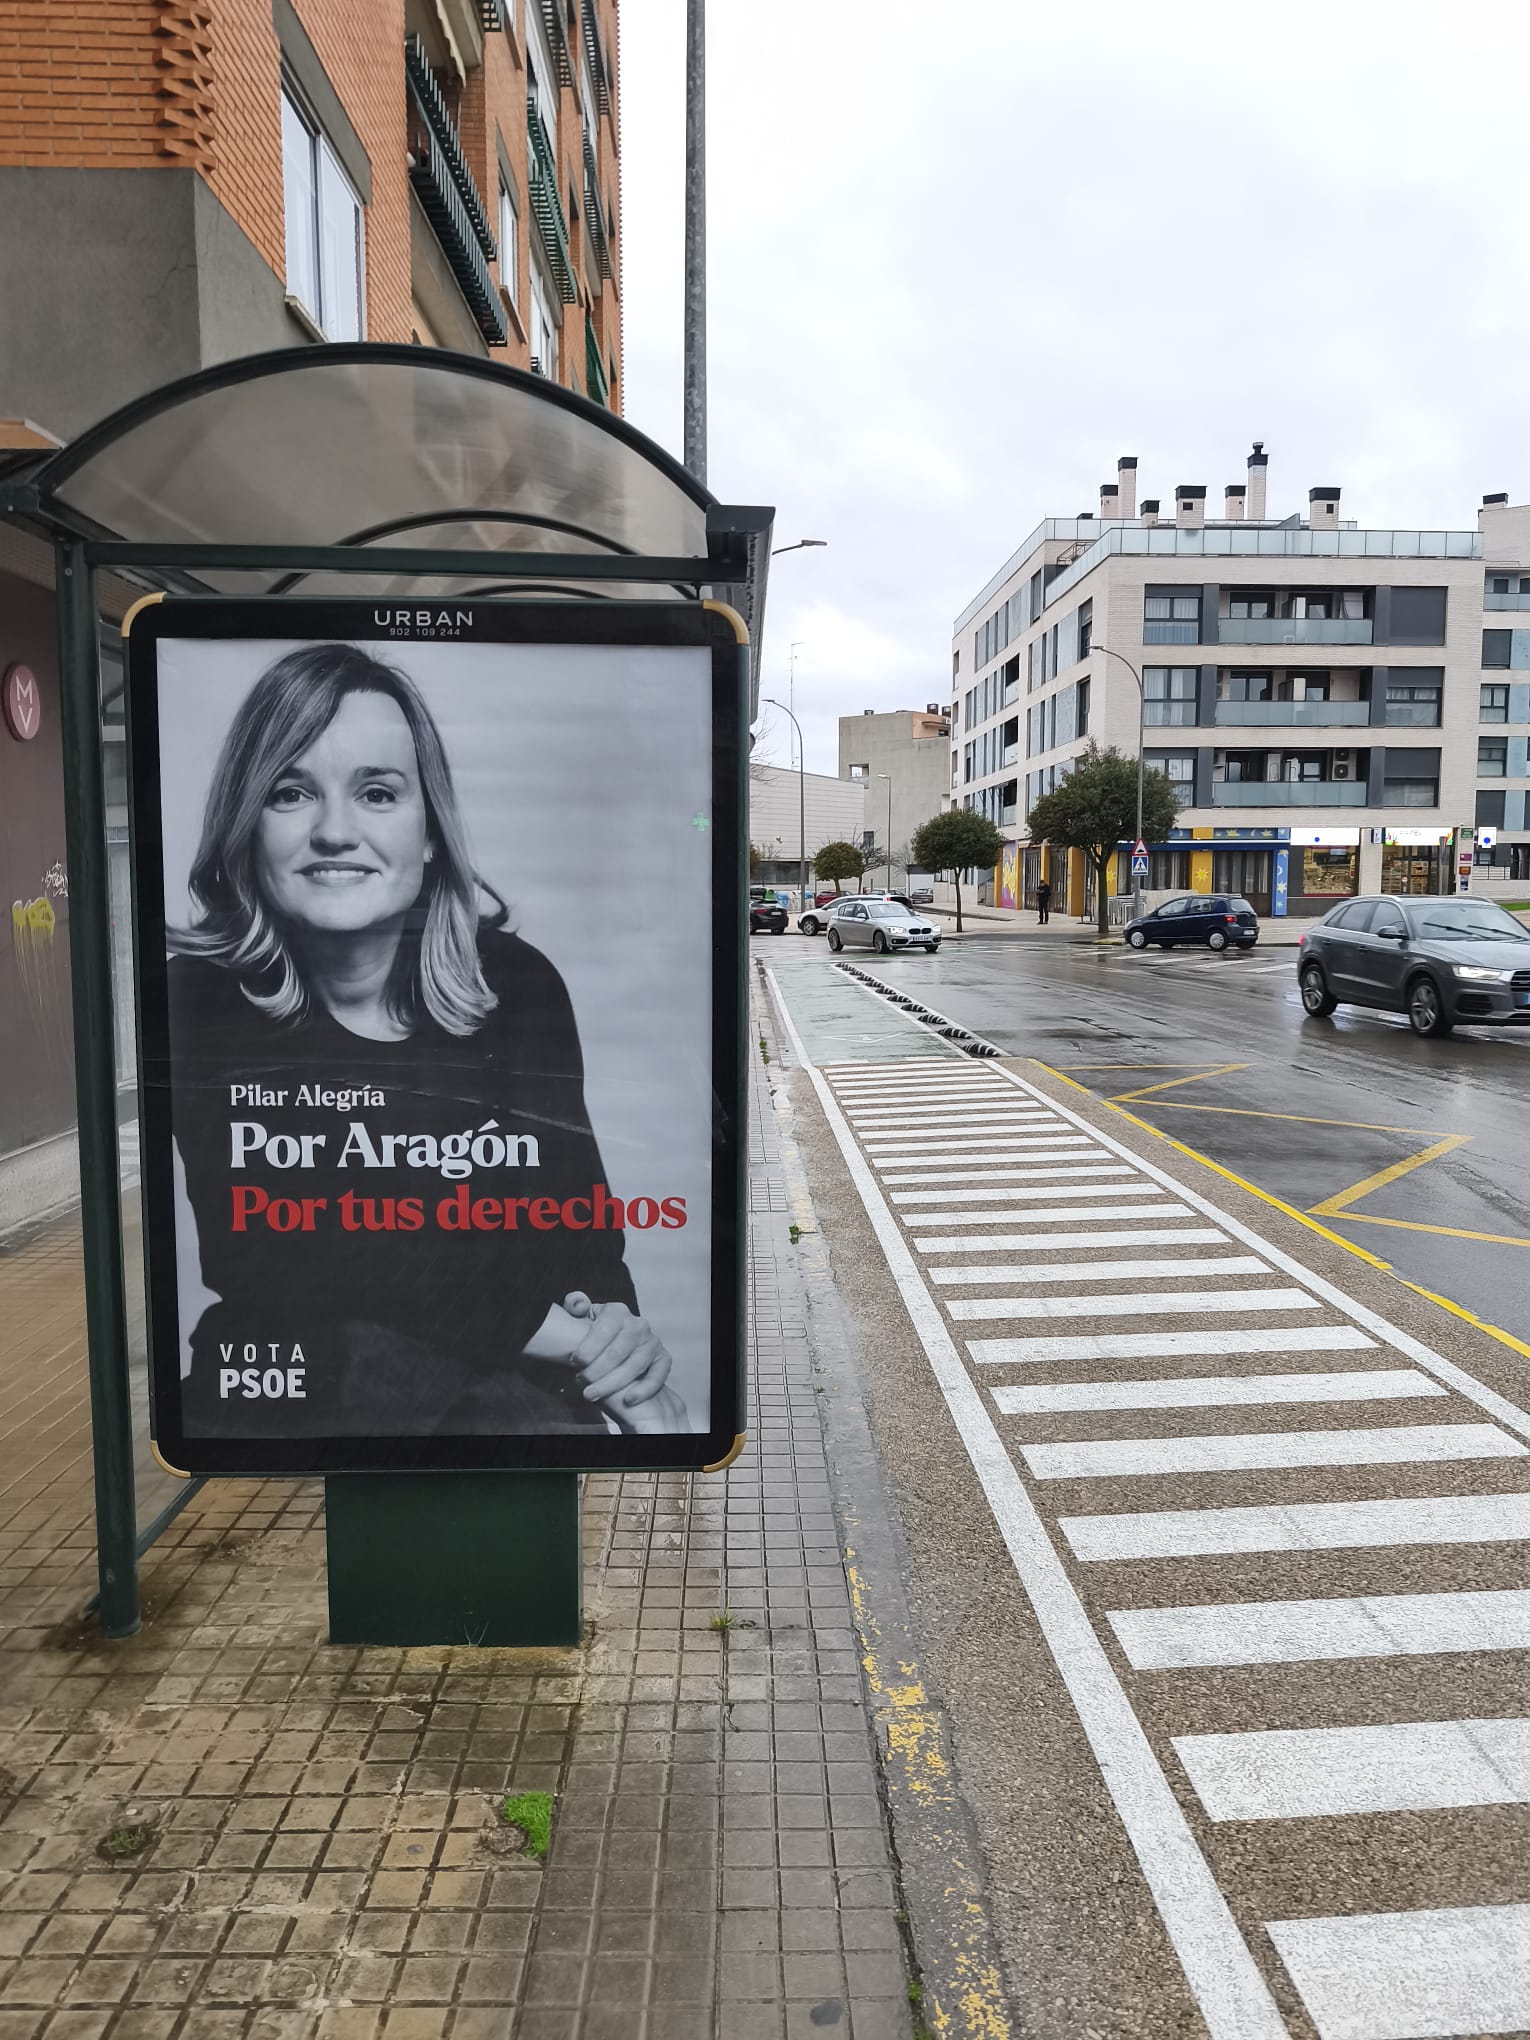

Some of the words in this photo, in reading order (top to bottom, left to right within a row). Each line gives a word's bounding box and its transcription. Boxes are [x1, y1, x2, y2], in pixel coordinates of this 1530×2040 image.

[374, 610, 473, 626] URBAN
[389, 627, 410, 636] 902
[416, 627, 436, 636] 109
[440, 628, 461, 636] 244
[231, 1083, 288, 1106] Pilar
[295, 1084, 385, 1111] Alegría
[231, 1122, 326, 1168] Por
[337, 1118, 540, 1178] Aragón
[231, 1186, 326, 1232] Por
[338, 1191, 424, 1231] tus
[436, 1184, 686, 1230] derechos
[220, 1344, 304, 1362] VOTA
[220, 1369, 306, 1398] PSOE
